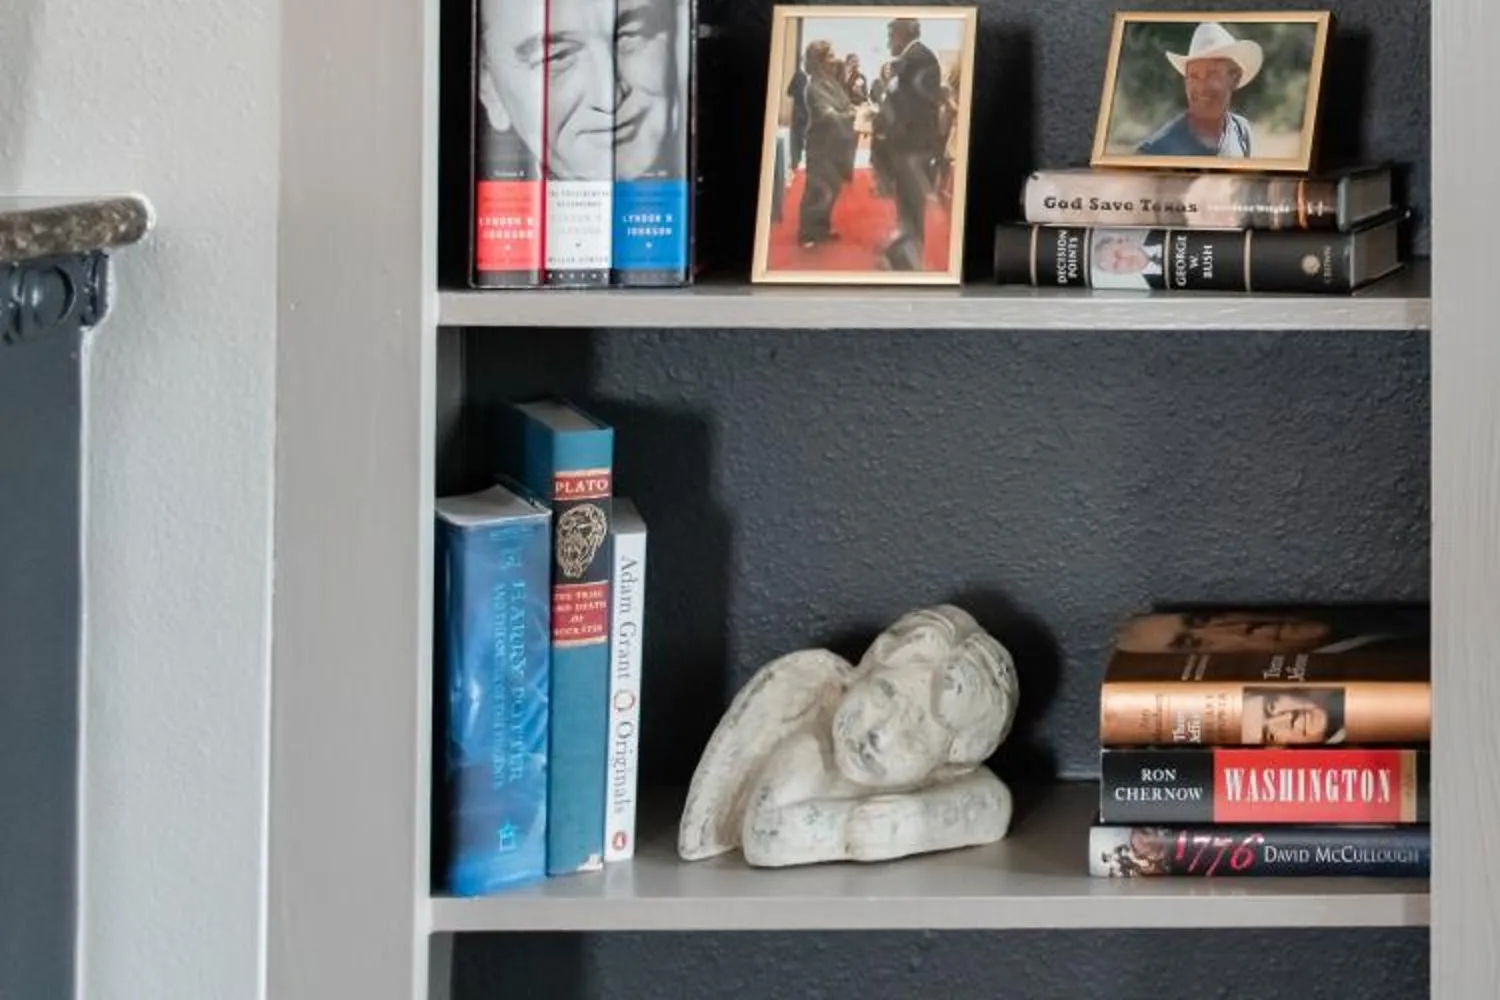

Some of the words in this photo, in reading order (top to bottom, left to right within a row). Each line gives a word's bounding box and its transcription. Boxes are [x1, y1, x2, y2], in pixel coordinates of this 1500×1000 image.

[1043, 195, 1082, 211] God
[1088, 195, 1134, 213] Save
[1141, 198, 1198, 214] Texas
[1056, 230, 1068, 284] DECISION
[1068, 236, 1079, 279] POINTS
[1175, 235, 1188, 287] GEORGE
[1203, 245, 1215, 279] BUSH
[554, 478, 609, 494] PLATO
[619, 554, 640, 616] Adam
[509, 579, 527, 679] HARRY
[615, 621, 637, 691] Grant
[508, 685, 526, 784] POTTER
[611, 720, 635, 814] Originals
[1141, 768, 1176, 782] RON
[1223, 767, 1392, 803] WASHINGTON
[1114, 786, 1203, 801] CHERNOW
[1175, 832, 1265, 877] 1776
[1264, 846, 1310, 863] DAVID
